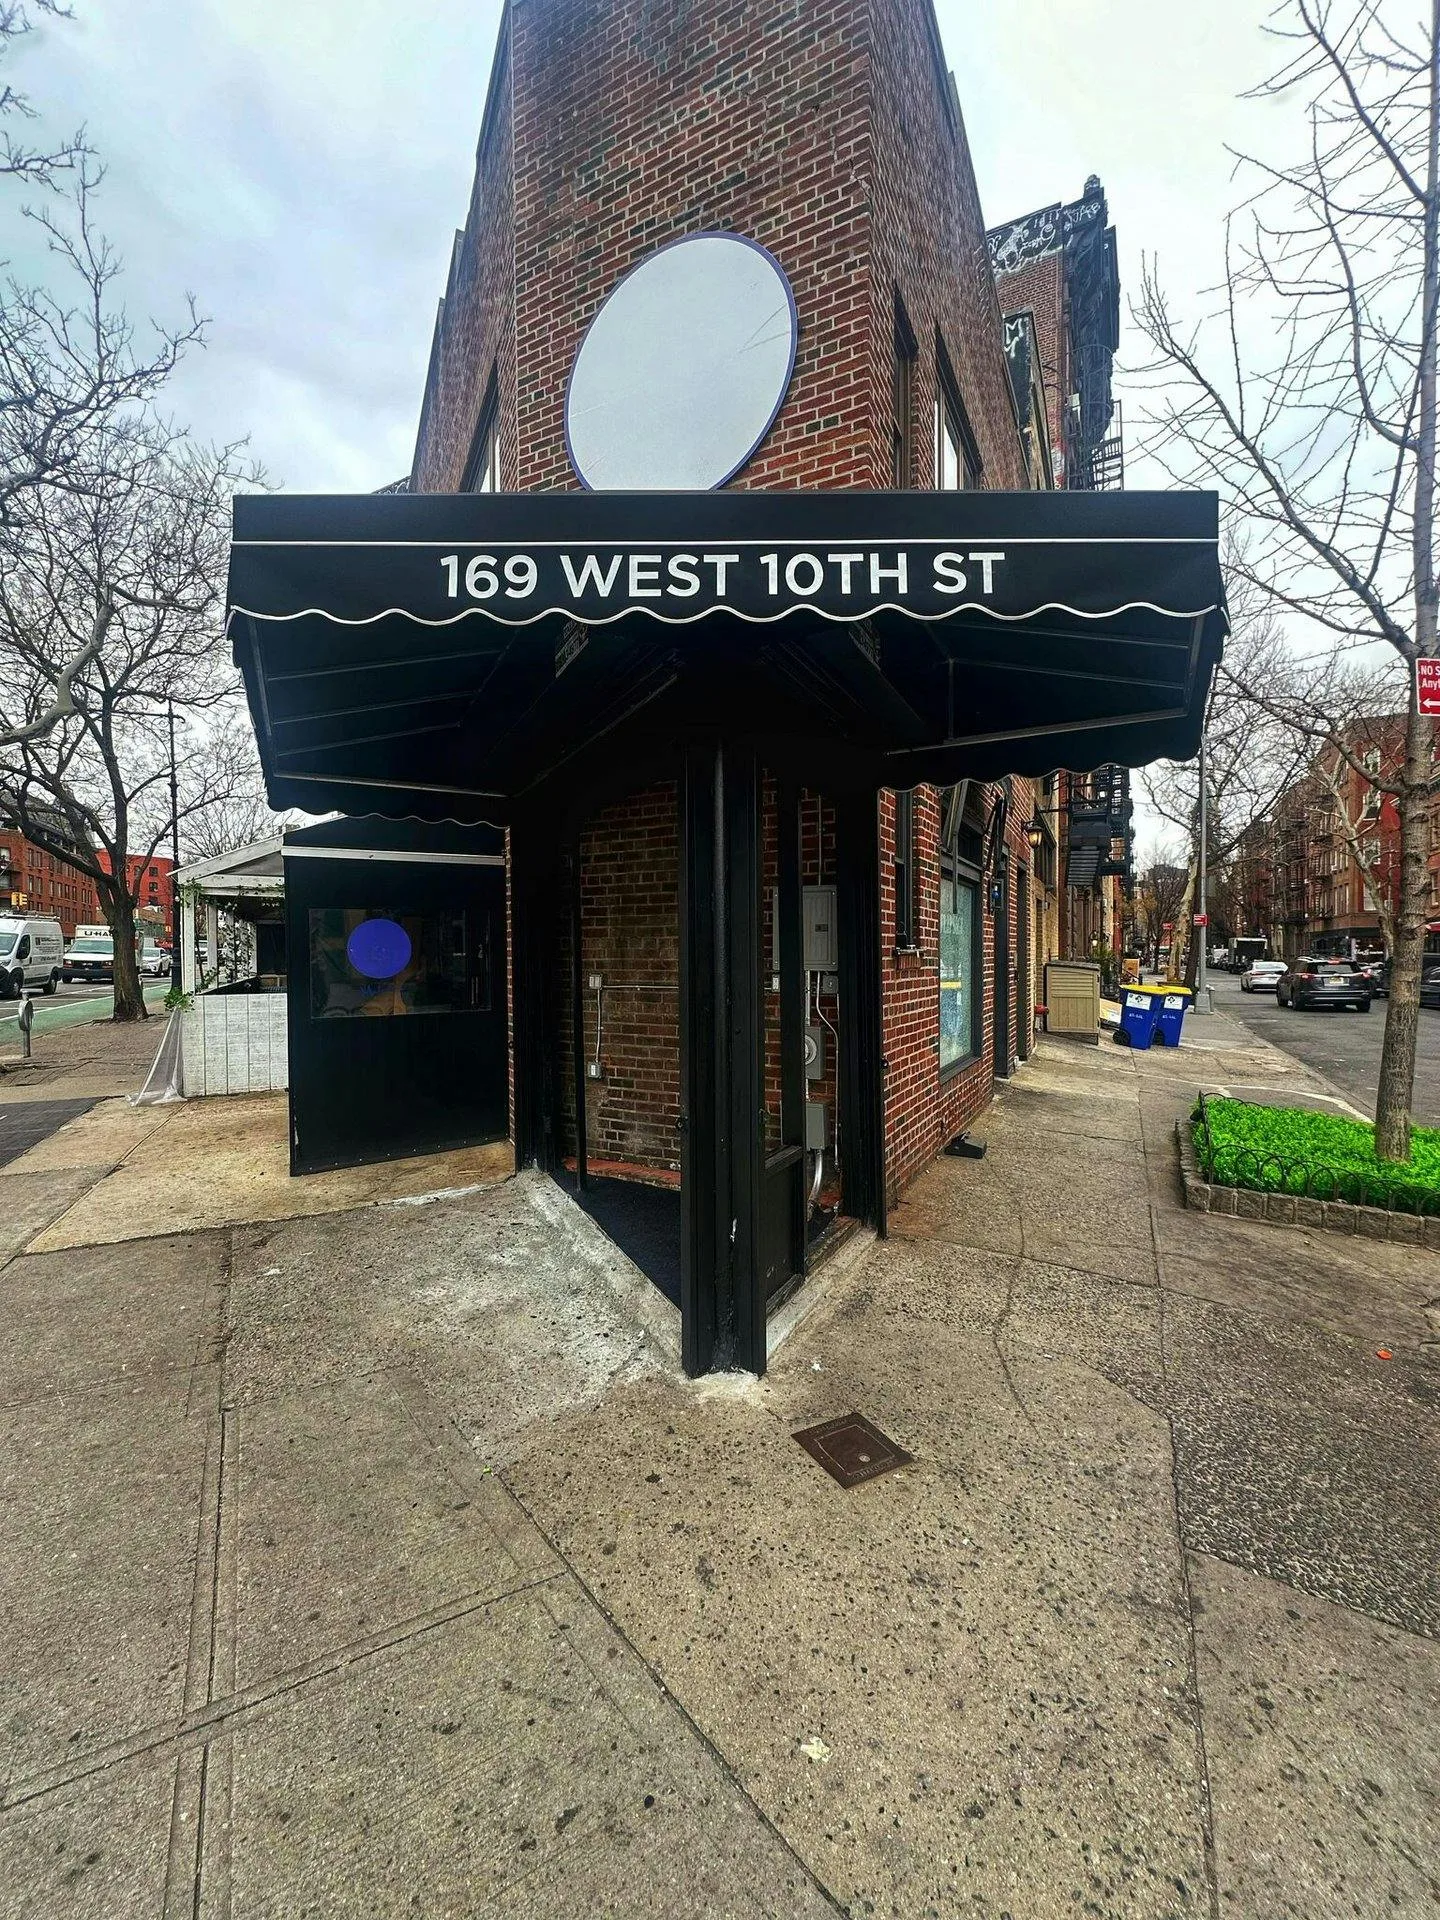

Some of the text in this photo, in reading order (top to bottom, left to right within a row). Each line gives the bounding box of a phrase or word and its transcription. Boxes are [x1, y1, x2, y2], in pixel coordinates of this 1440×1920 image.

[441, 551, 1006, 599] 169 WEST 10TH ST
[1420, 665, 1433, 675] NO
